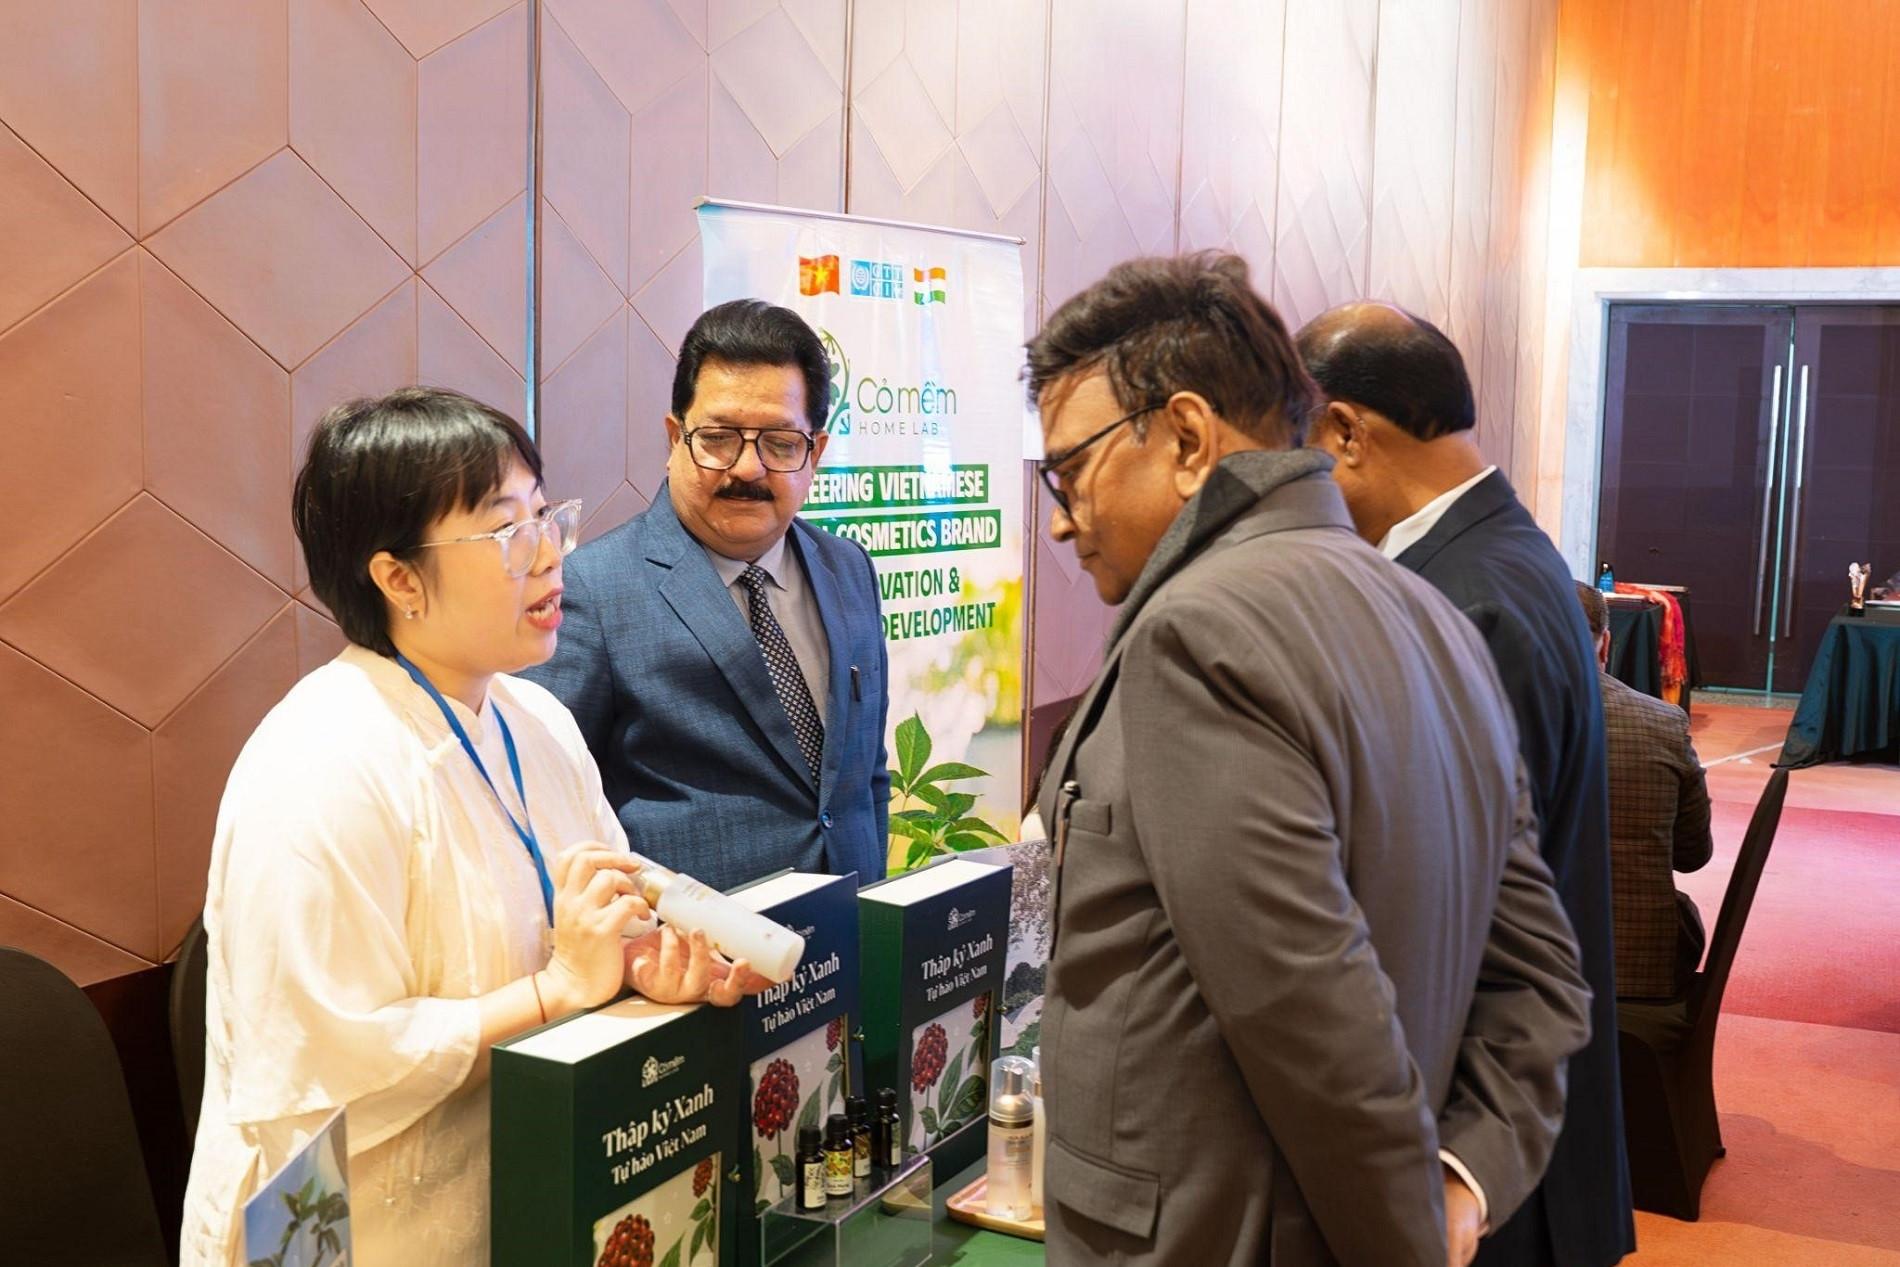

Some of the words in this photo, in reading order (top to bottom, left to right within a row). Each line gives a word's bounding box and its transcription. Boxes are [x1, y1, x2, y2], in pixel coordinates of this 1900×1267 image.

[859, 421, 905, 435] HOME
[913, 422, 939, 435] LAB
[803, 471, 873, 504] EERING
[940, 515, 998, 546] BRAND
[949, 566, 960, 593] &
[808, 952, 840, 984] Xanh
[921, 954, 951, 980] Thập
[967, 933, 993, 960] Xanh
[815, 987, 836, 1007] Nam
[602, 1120, 649, 1157] Thập
[652, 1101, 672, 1135] kỷ
[673, 1083, 714, 1123] Xanh
[611, 1161, 630, 1185] Tự
[632, 1152, 655, 1175] hào
[655, 1138, 680, 1161] Việt
[681, 1124, 707, 1148] Nam
